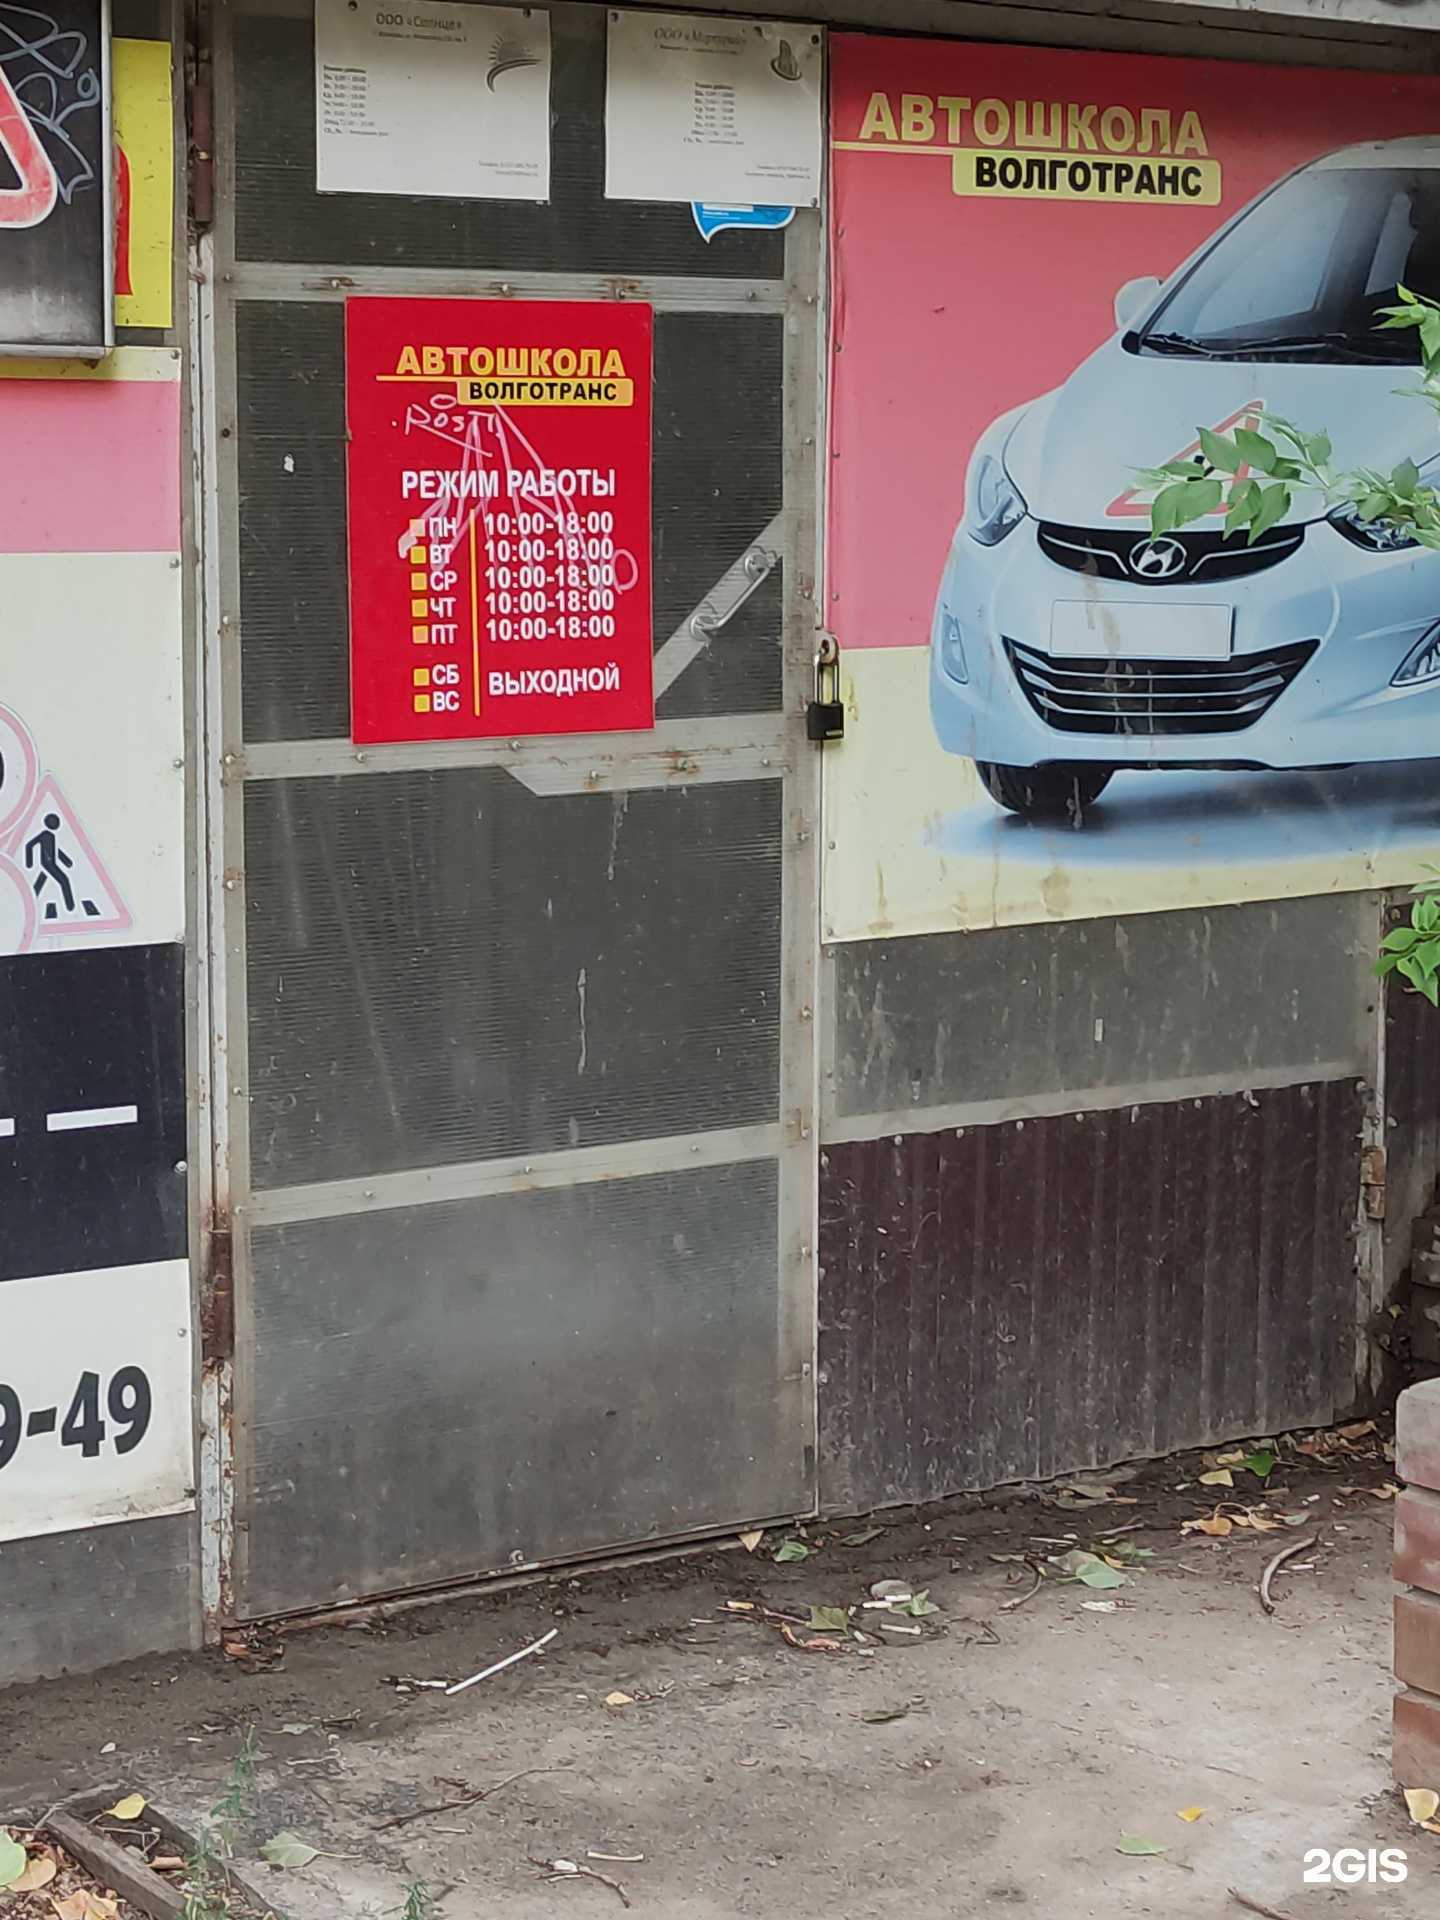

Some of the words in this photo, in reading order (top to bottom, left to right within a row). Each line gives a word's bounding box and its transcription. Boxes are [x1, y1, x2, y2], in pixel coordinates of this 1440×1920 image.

[858, 91, 1209, 156] АВТОШКОЛА
[974, 156, 1203, 197] ВОЛГОТРАНС
[396, 345, 627, 377] АВТОШКОЛА
[469, 382, 617, 401] ВОЛГОТРАНС
[402, 470, 499, 499] РЕЖИМ
[507, 469, 616, 498] РАБОТЫ
[428, 518, 458, 538] ПН
[485, 511, 615, 536] 10:00-18:00
[429, 545, 454, 565] ВТ
[485, 537, 615, 563] 10:00-18:00
[430, 571, 458, 592] СР
[485, 564, 615, 590] 10:00-18:00
[430, 597, 457, 618] ЧТ
[485, 589, 615, 615] 10:00-18:00
[431, 624, 459, 645] ПТ
[485, 616, 615, 642] 10:00-18:00
[432, 664, 460, 685] СБ
[488, 662, 620, 697] ВЫХОДНОЙ
[432, 691, 460, 713] ВС
